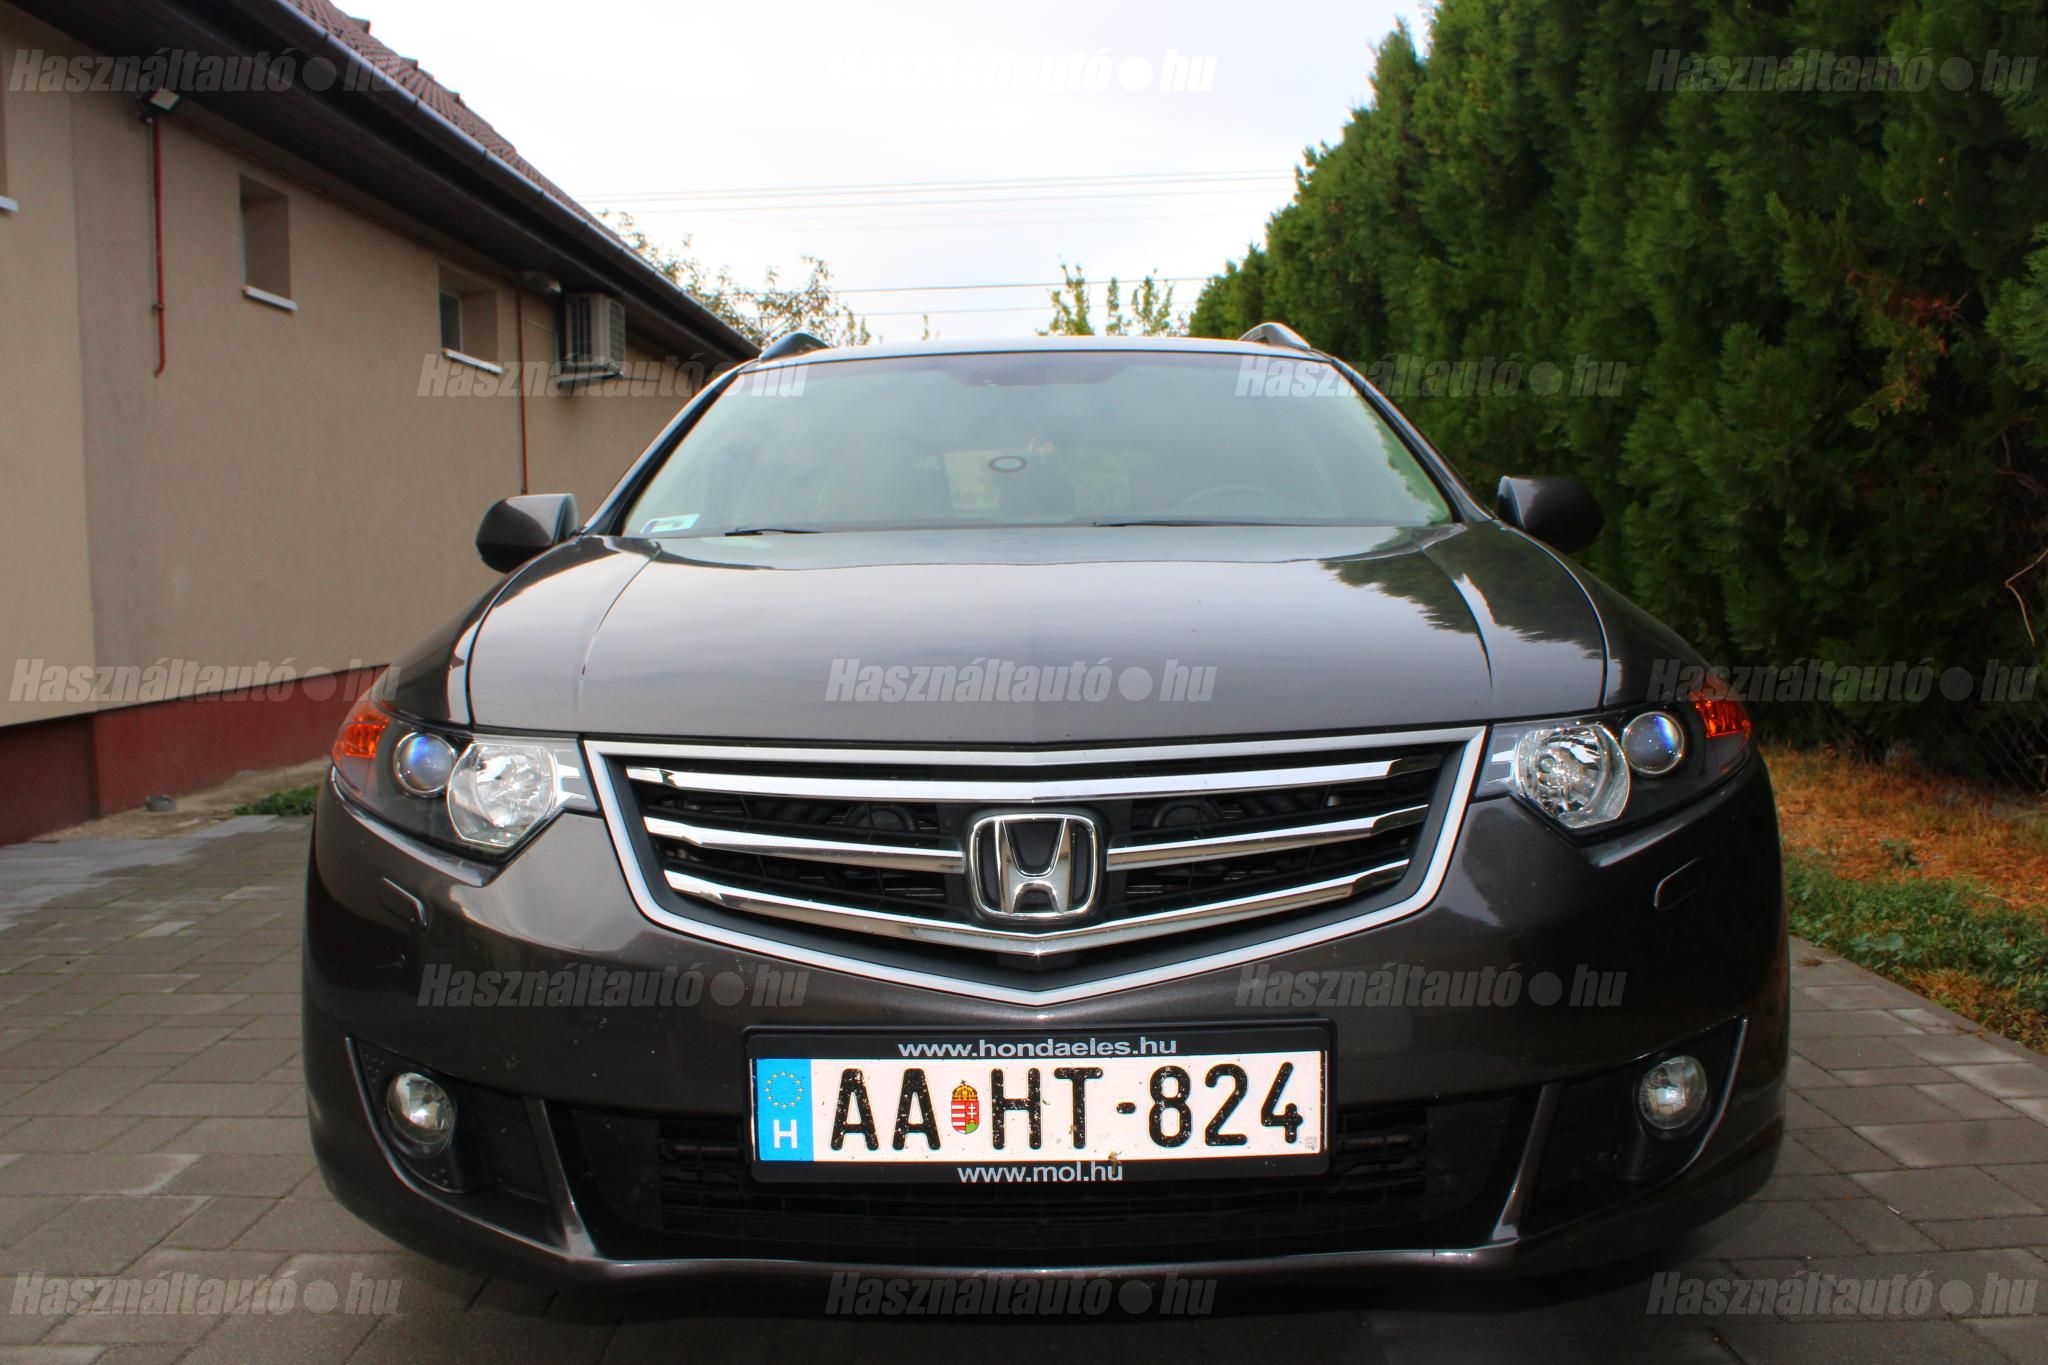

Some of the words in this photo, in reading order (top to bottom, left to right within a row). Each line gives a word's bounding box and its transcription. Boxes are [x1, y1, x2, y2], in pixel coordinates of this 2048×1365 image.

[898, 1037, 1177, 1057] www.hondaeles.hu
[773, 1119, 798, 1148] H
[957, 1161, 1124, 1183] www.mol.hu
